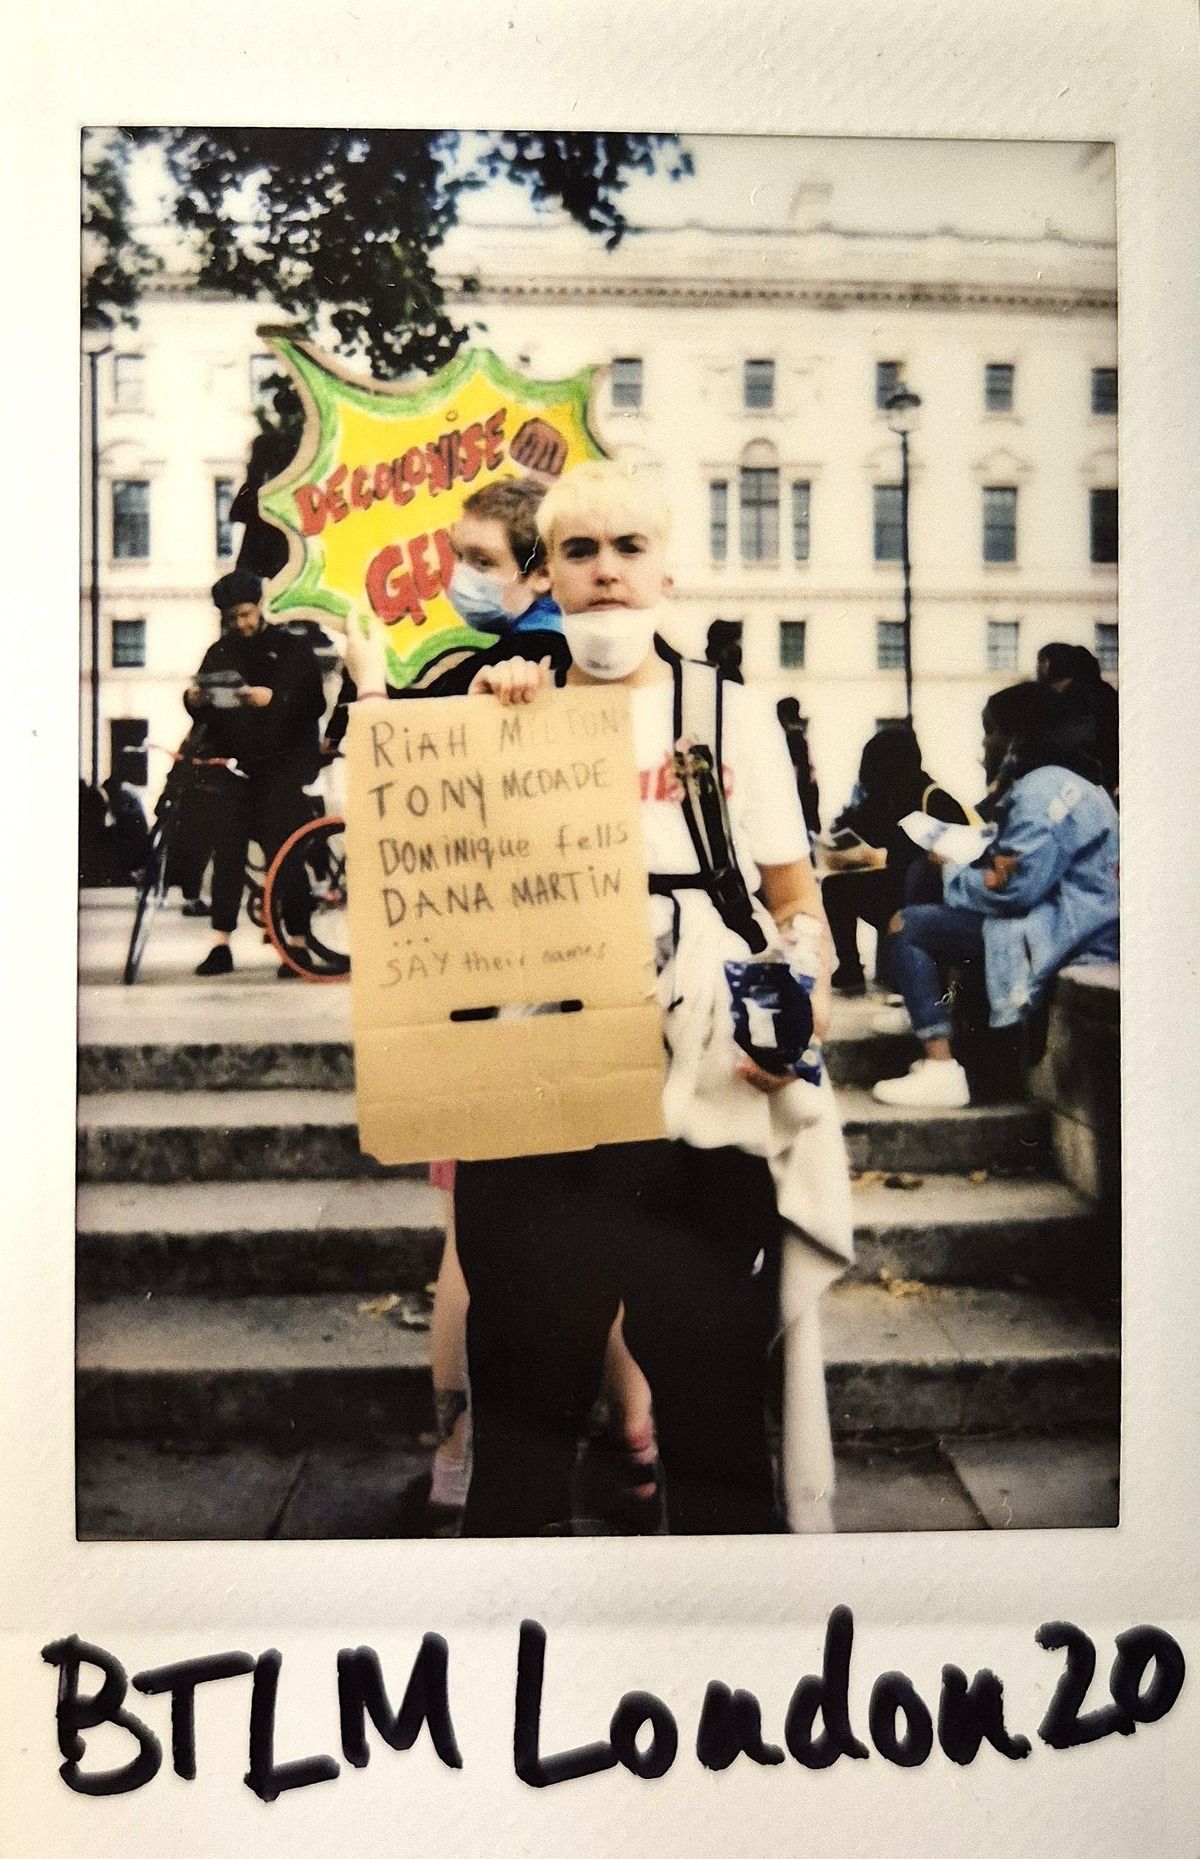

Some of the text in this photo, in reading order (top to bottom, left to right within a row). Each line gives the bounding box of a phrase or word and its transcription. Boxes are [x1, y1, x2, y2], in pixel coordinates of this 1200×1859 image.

[293, 407, 507, 537] DECOLONISE
[368, 771, 487, 827] TONY
[382, 884, 494, 928] DANA
[379, 950, 450, 988] SAY
[40, 1634, 463, 1803] BTLM
